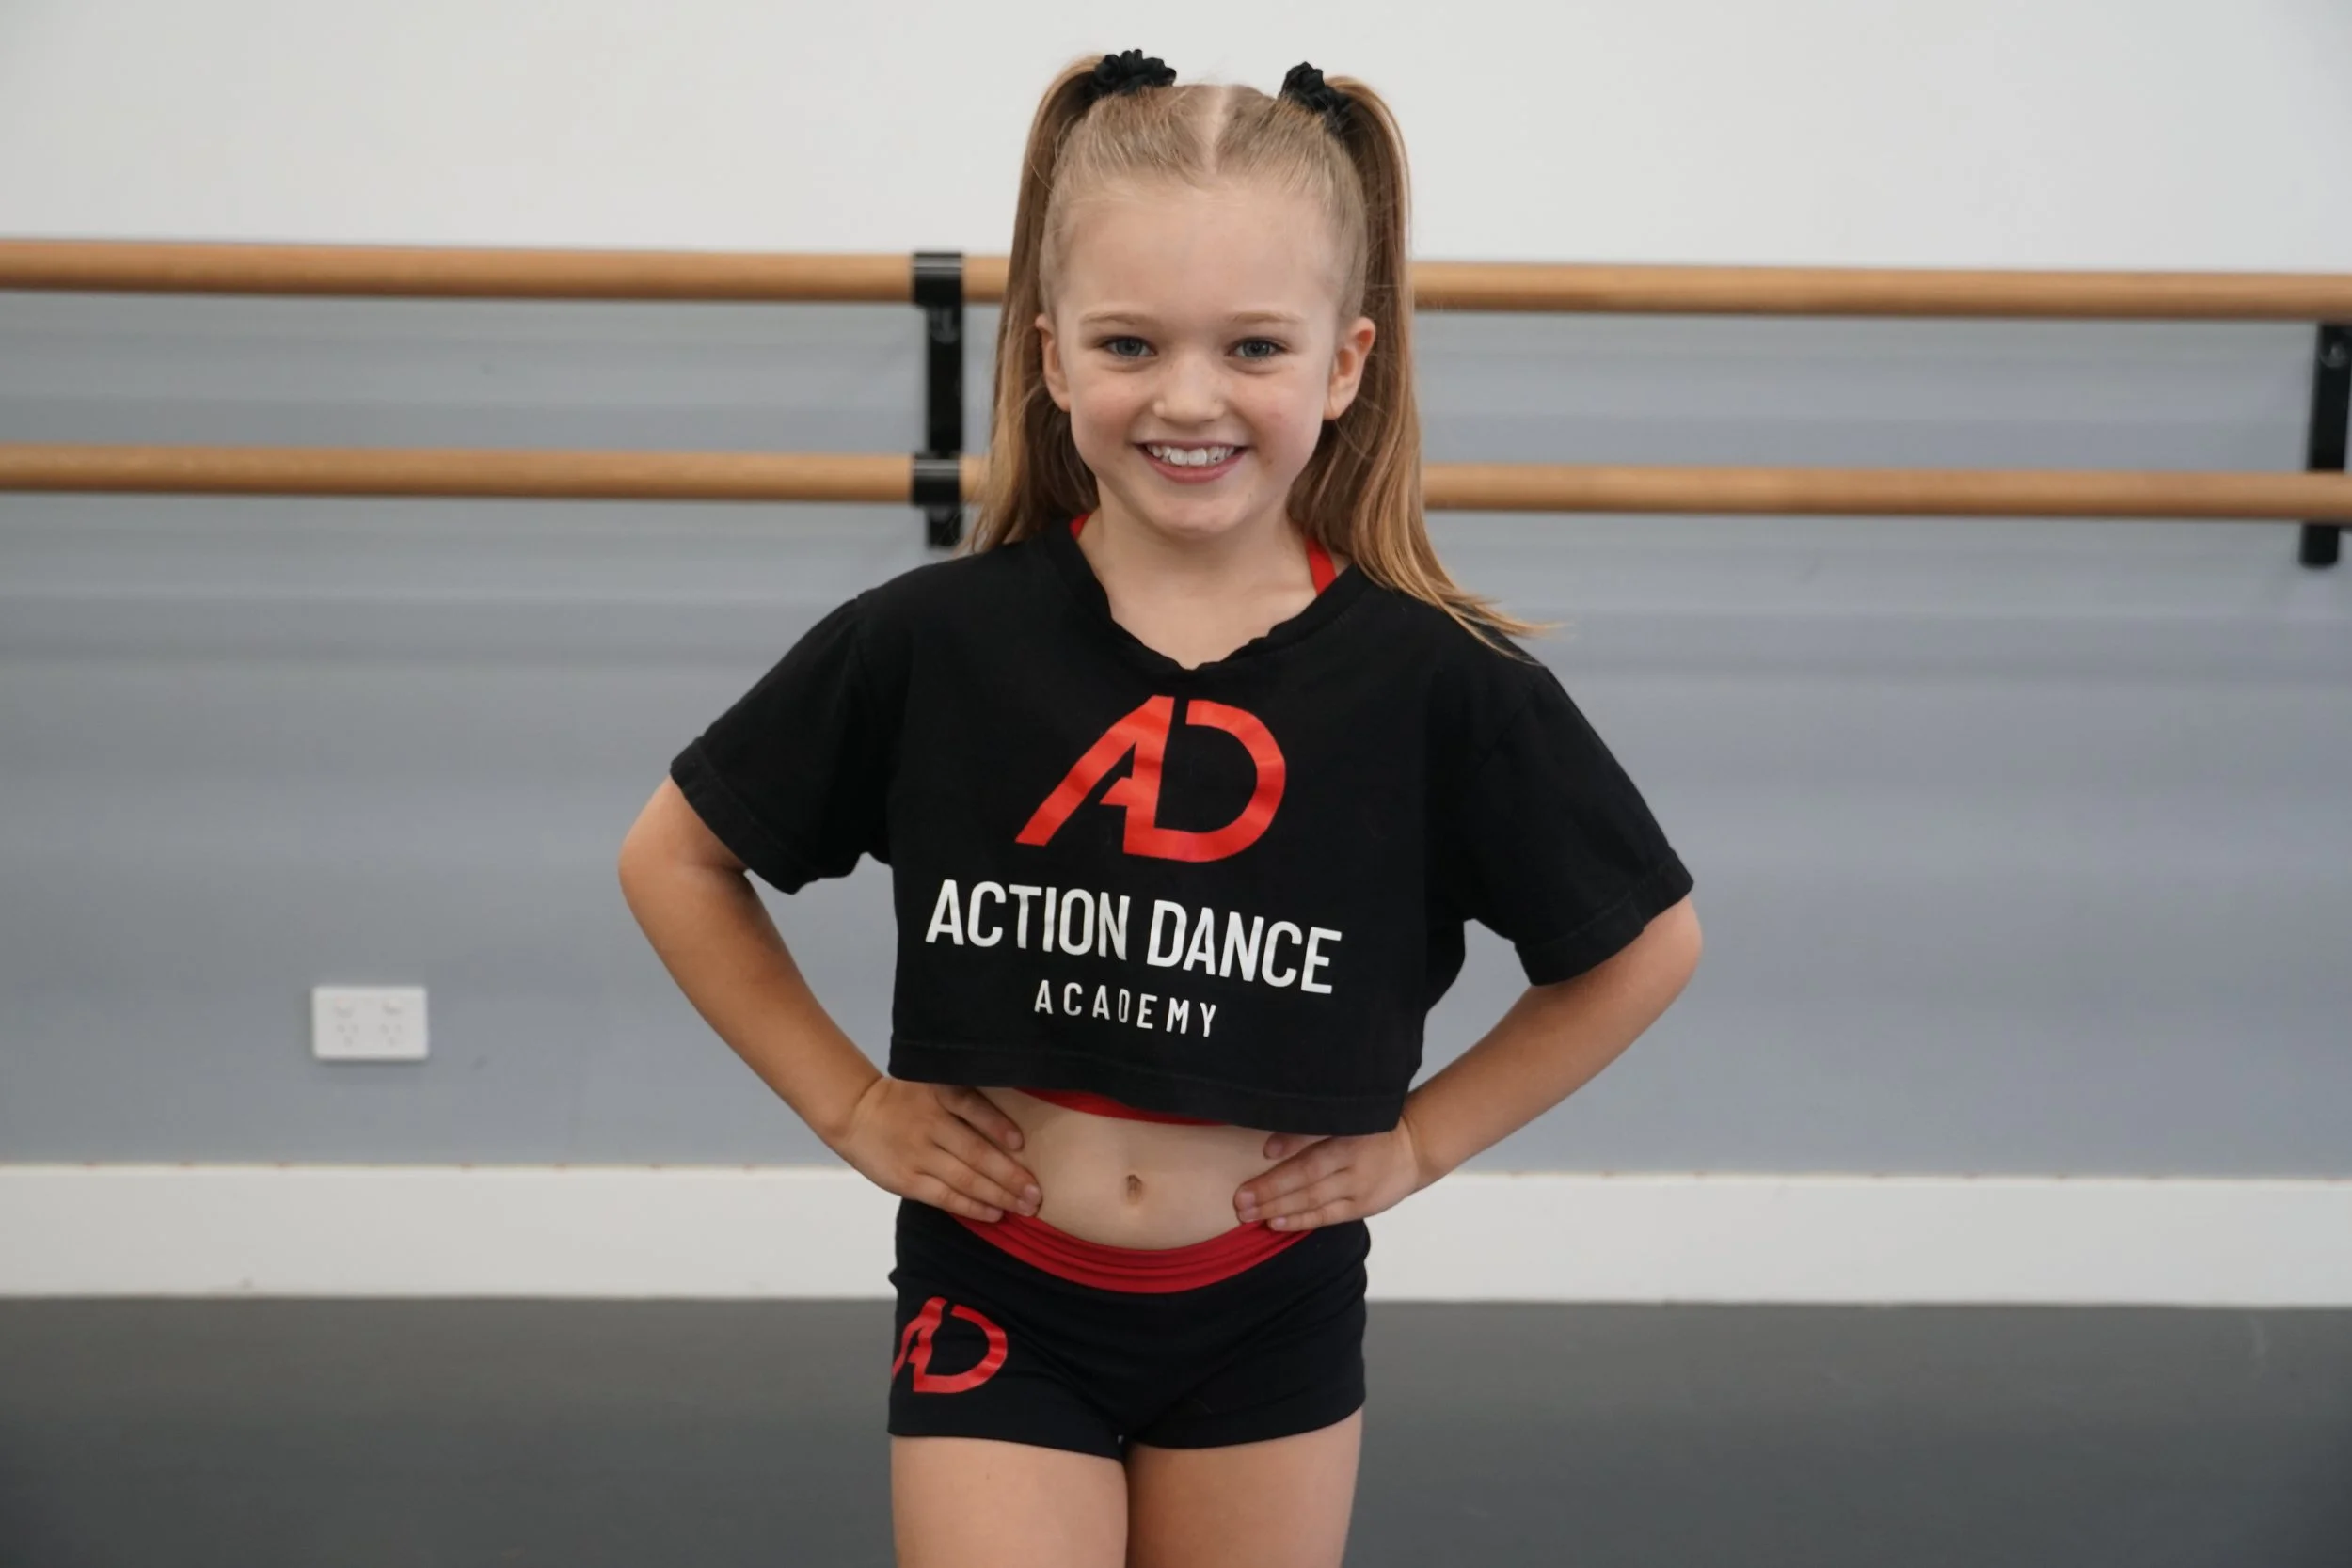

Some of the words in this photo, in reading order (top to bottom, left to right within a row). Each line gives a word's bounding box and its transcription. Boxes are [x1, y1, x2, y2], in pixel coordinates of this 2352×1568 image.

[1015, 695, 1286, 863] AD
[925, 879, 1131, 961] ACTION
[1147, 899, 1343, 995] DANCE
[1033, 979, 1218, 1038] ACADEMY
